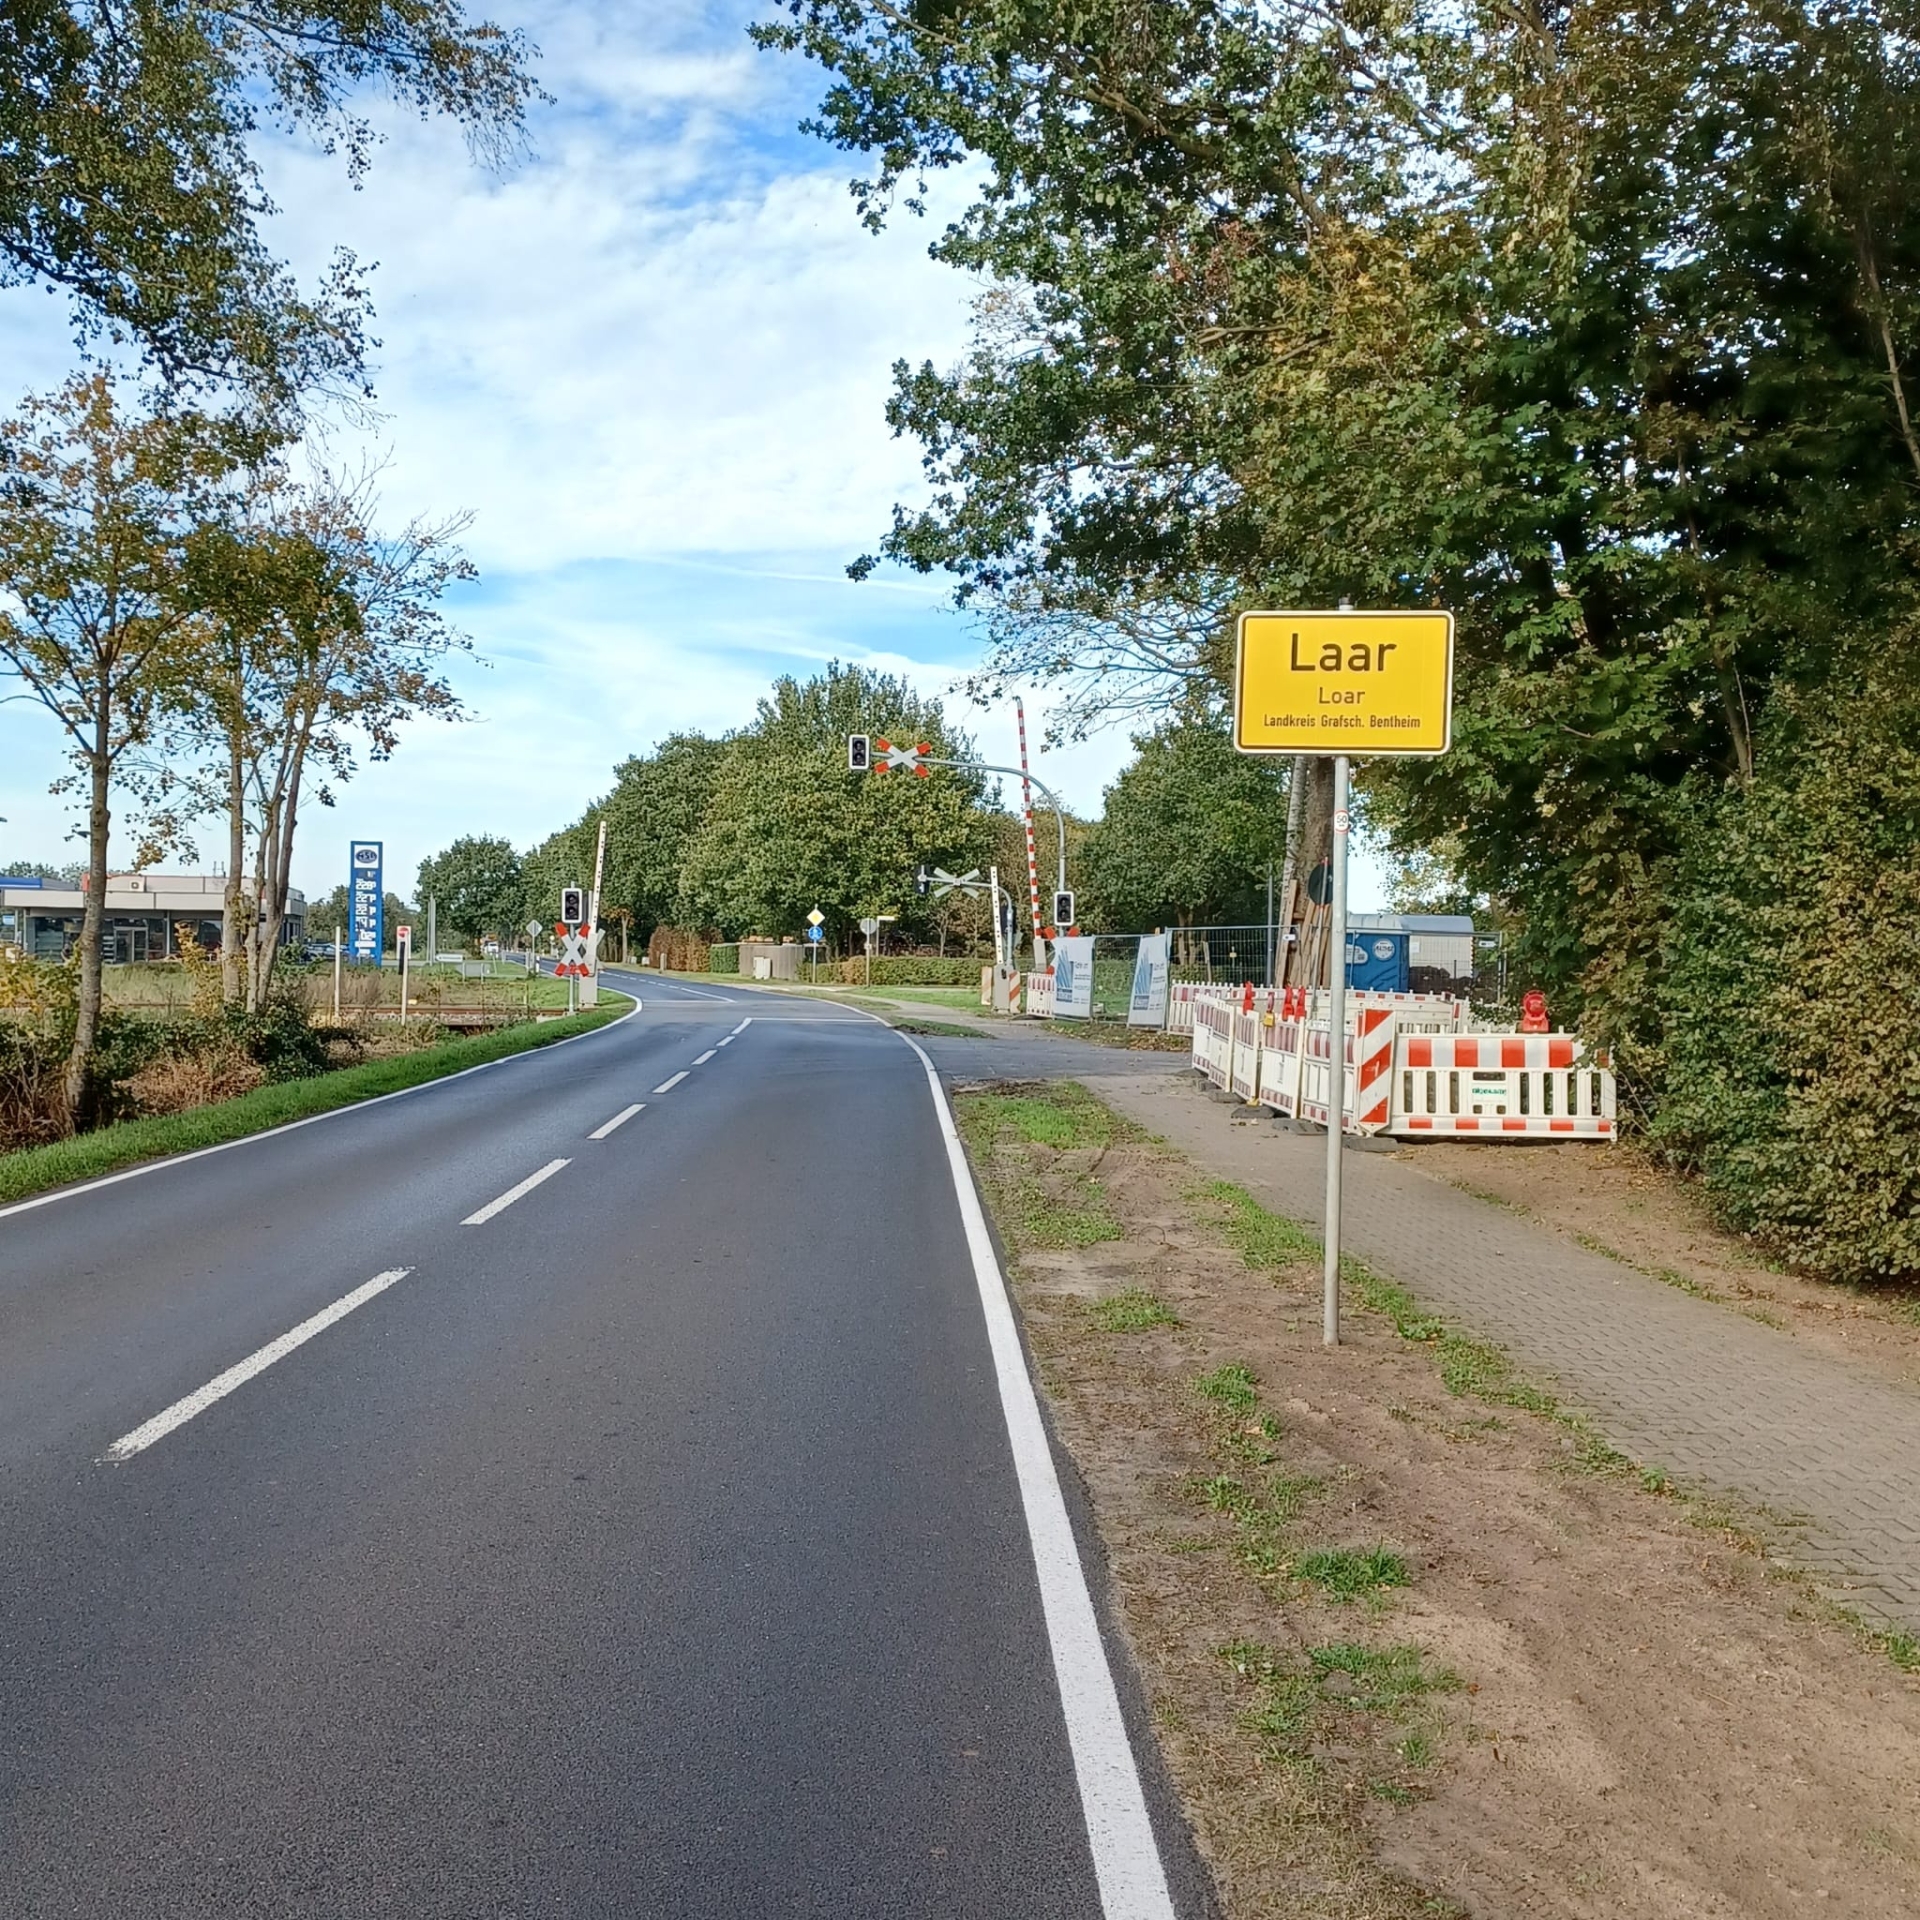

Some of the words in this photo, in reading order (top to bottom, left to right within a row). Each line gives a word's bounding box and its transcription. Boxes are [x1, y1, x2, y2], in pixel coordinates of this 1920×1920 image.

[1290, 632, 1397, 672] Laar
[1318, 686, 1366, 704] Loar
[1264, 714, 1316, 727] Landkreis
[1321, 715, 1365, 728] Grafsch.
[1369, 715, 1421, 728] Bentheim
[1336, 814, 1347, 824] 50
